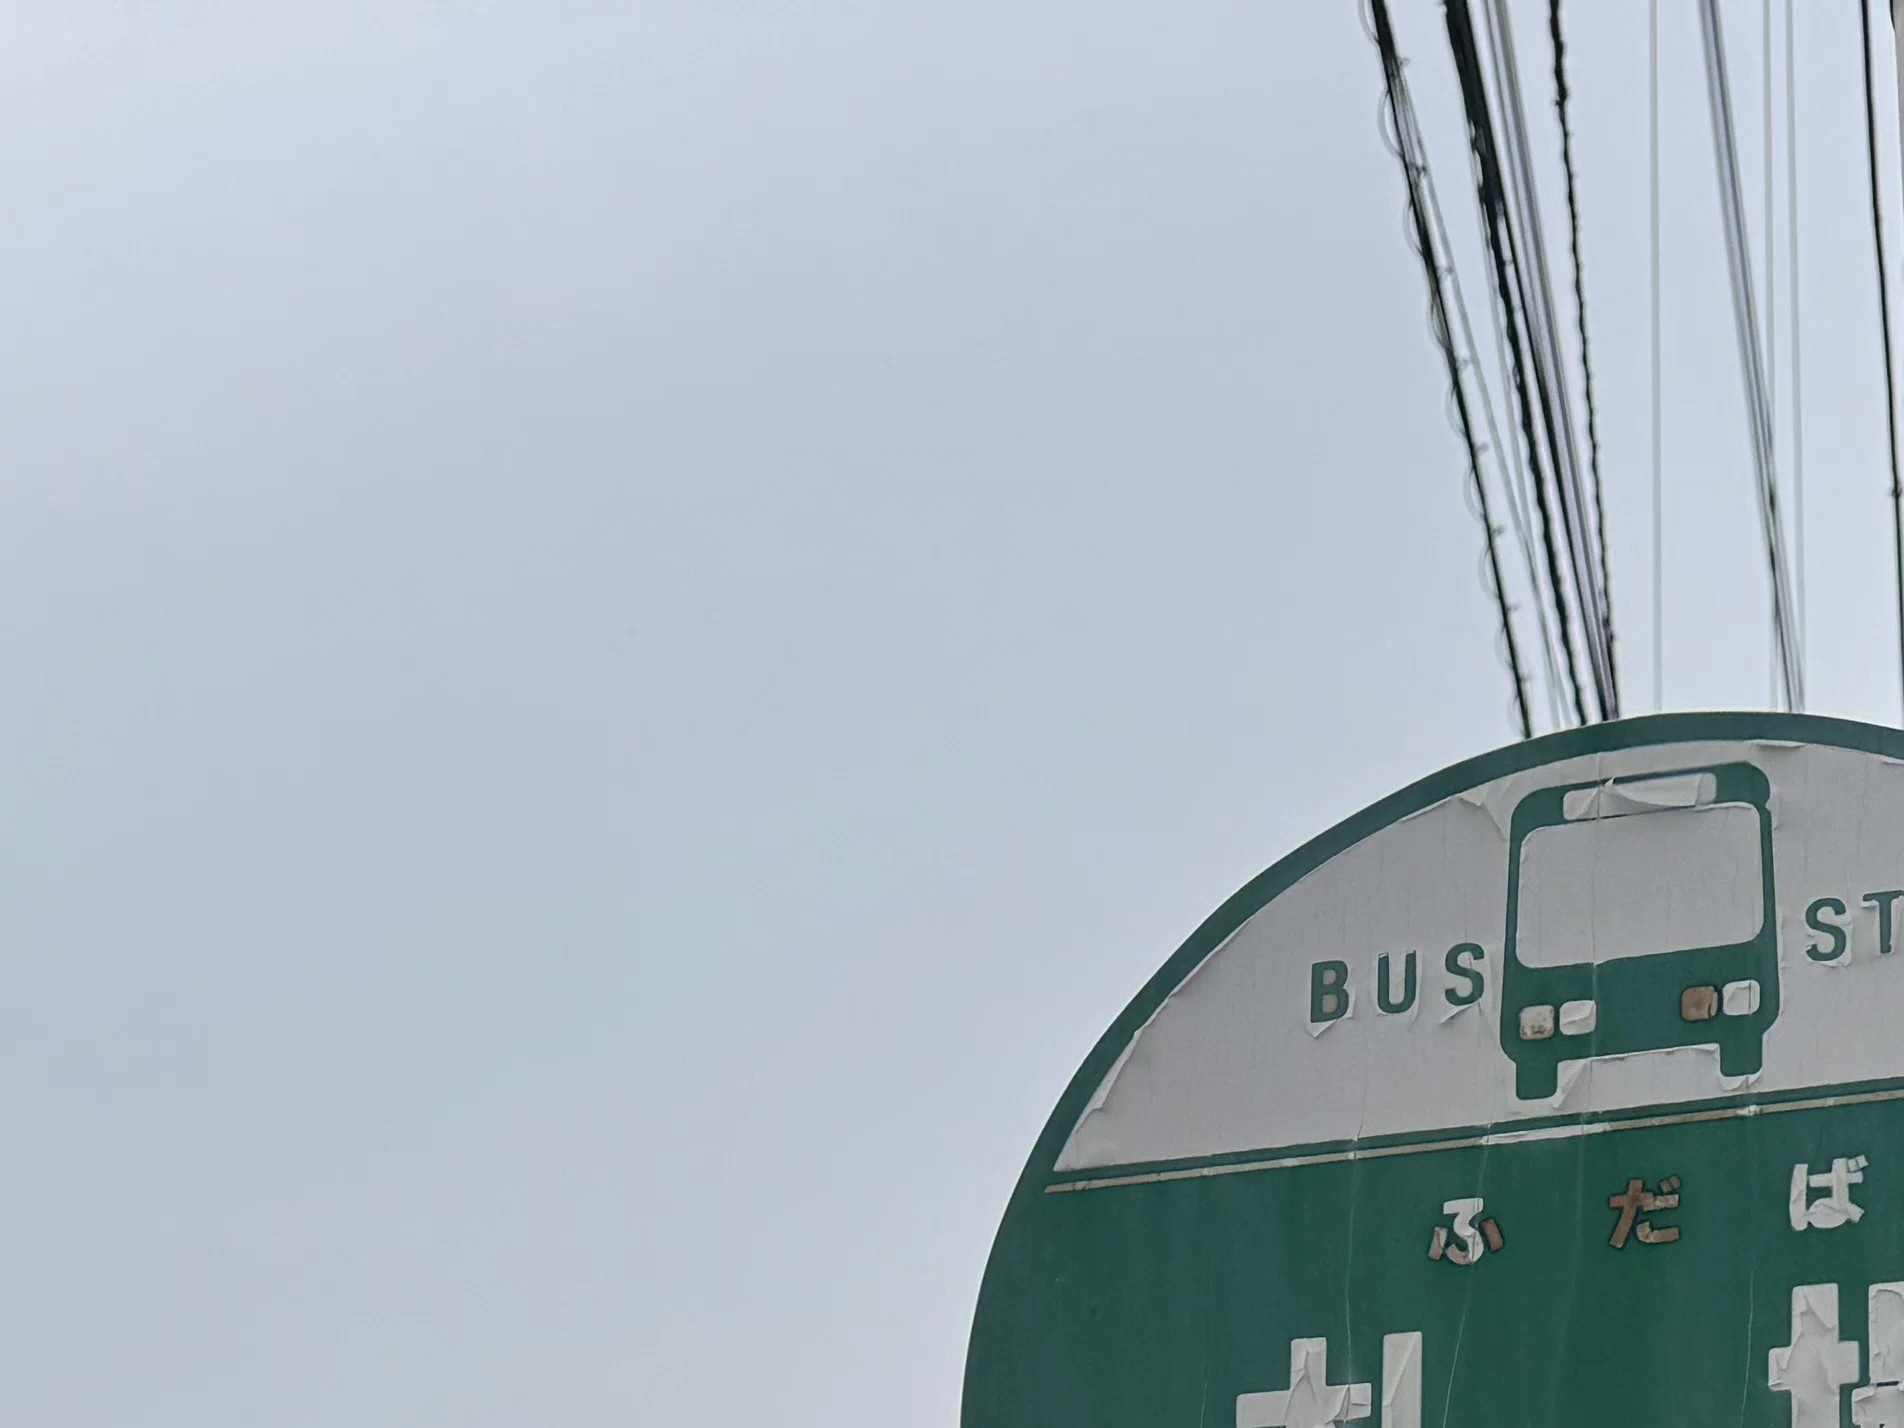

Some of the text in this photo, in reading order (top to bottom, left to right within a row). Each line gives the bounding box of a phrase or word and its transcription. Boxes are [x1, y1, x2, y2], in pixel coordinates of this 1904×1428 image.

[1309, 940, 1488, 1024] BUS
[1427, 1154, 1869, 1266] ふだば
